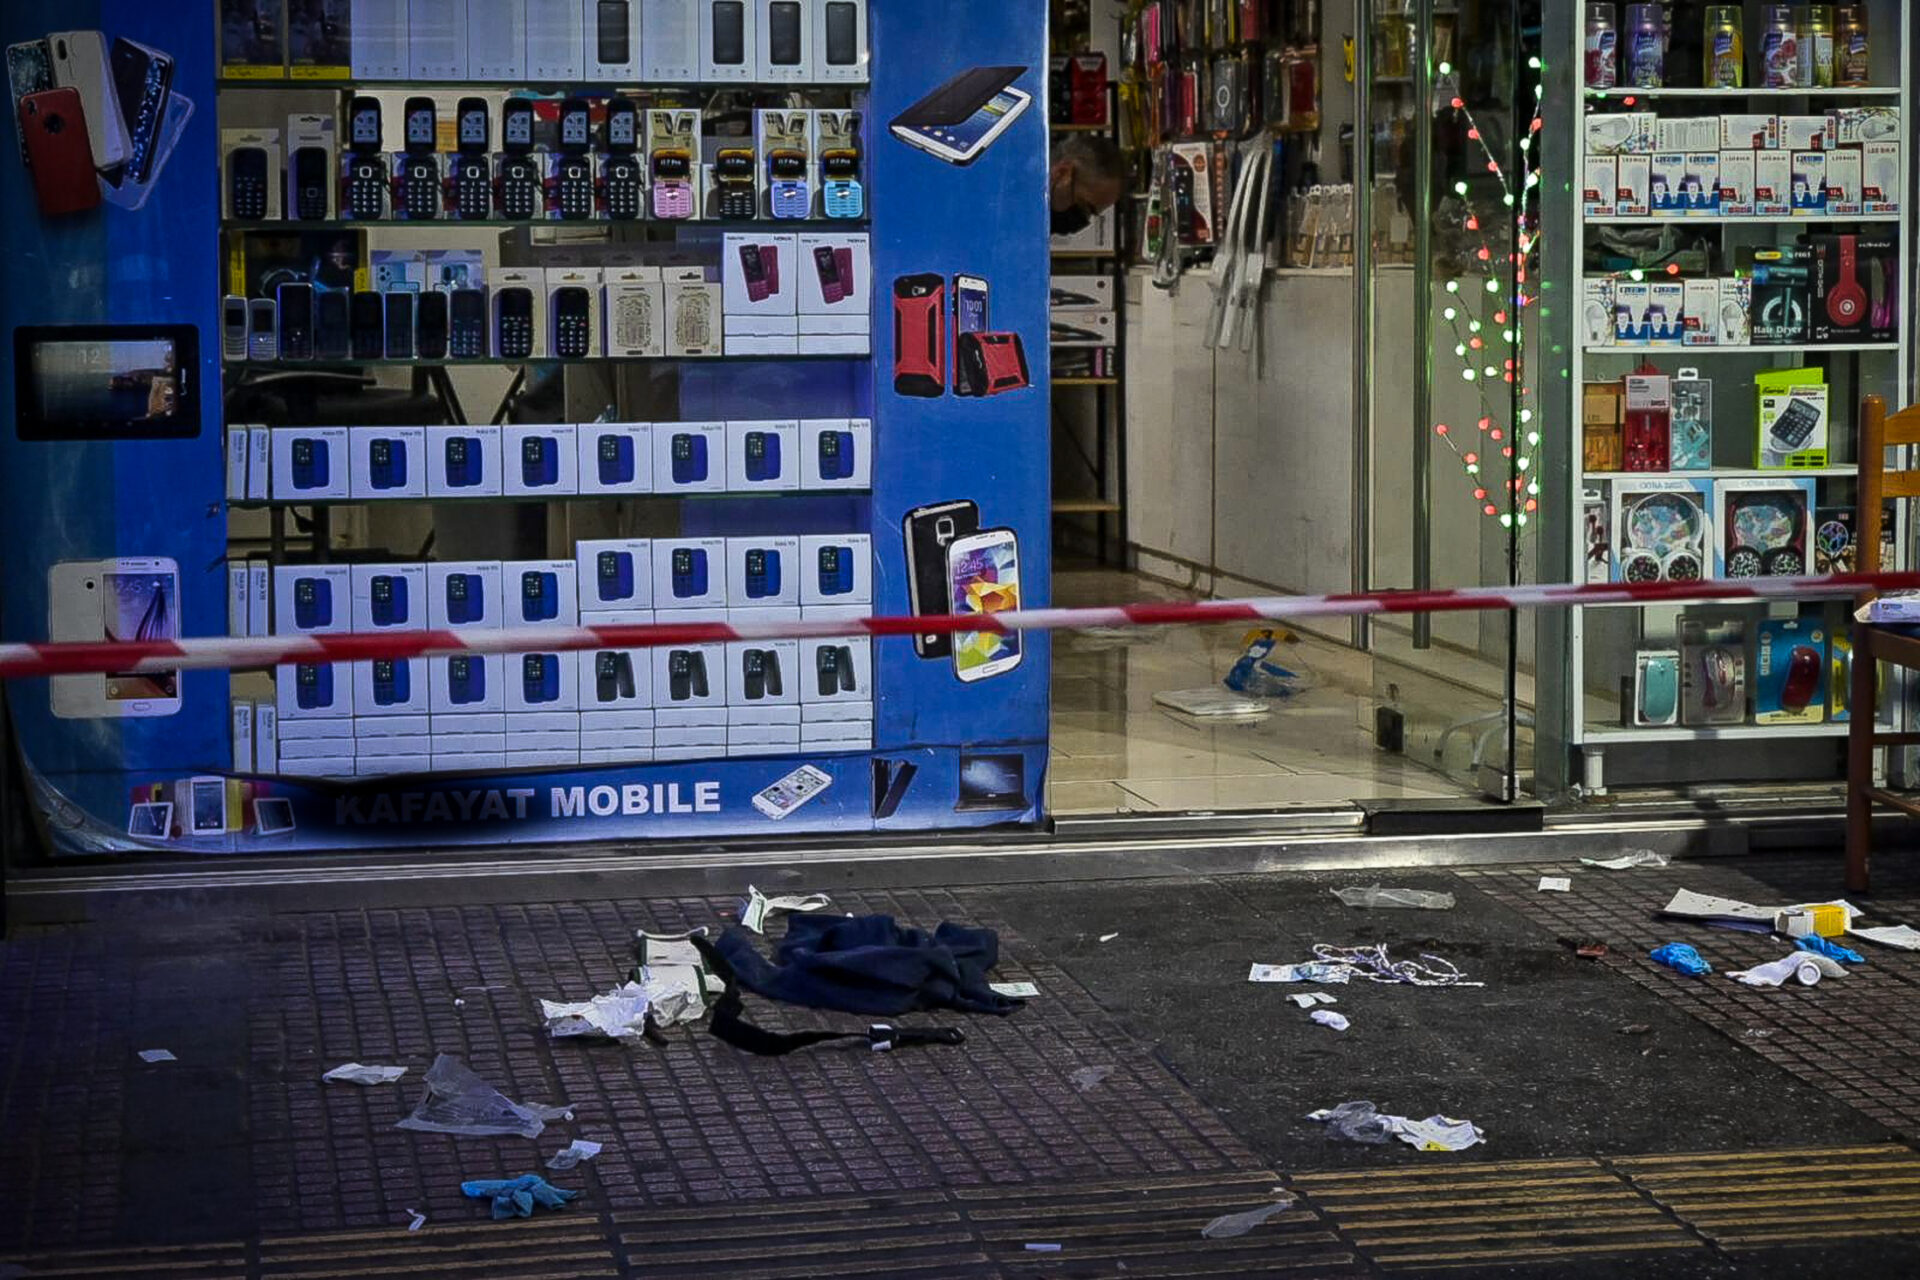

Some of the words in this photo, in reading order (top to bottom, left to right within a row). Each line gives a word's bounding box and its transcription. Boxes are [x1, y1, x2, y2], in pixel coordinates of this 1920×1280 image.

[1753, 325, 1773, 334] Hair
[1776, 325, 1803, 338] Dryer
[335, 788, 536, 825] KAFAYAT
[551, 781, 721, 817] MOBILE
